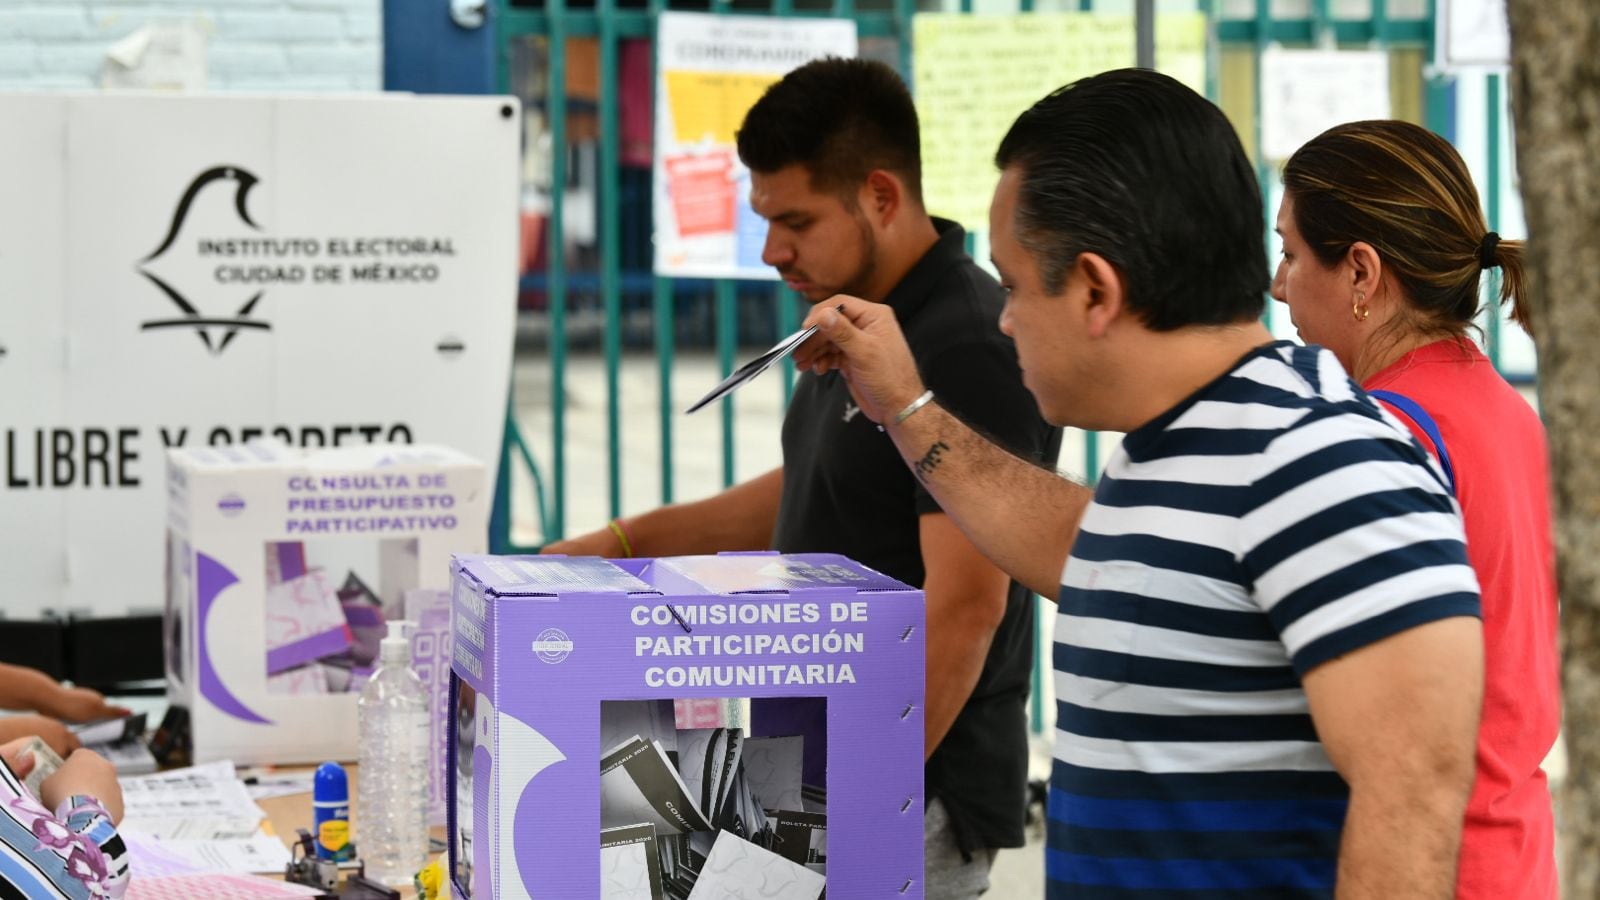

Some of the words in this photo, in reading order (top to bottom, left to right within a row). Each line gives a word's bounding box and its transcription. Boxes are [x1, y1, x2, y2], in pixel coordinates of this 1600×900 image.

[197, 239, 321, 256] INSTITUTO
[328, 238, 458, 256] ELECTORAL
[214, 266, 306, 284] CIUDAD
[313, 265, 343, 282] DE
[351, 260, 440, 282] MÉXICO
[7, 427, 141, 487] LIBRE
[417, 474, 447, 490] DE
[287, 494, 455, 513] PRESUPUESTO
[286, 515, 458, 534] PARTICIPATIVO
[630, 603, 820, 626] COMISIONES
[830, 602, 868, 622] DE
[635, 628, 864, 657] PARTICIPACIÓN
[644, 664, 856, 688] COMUNITARIA
